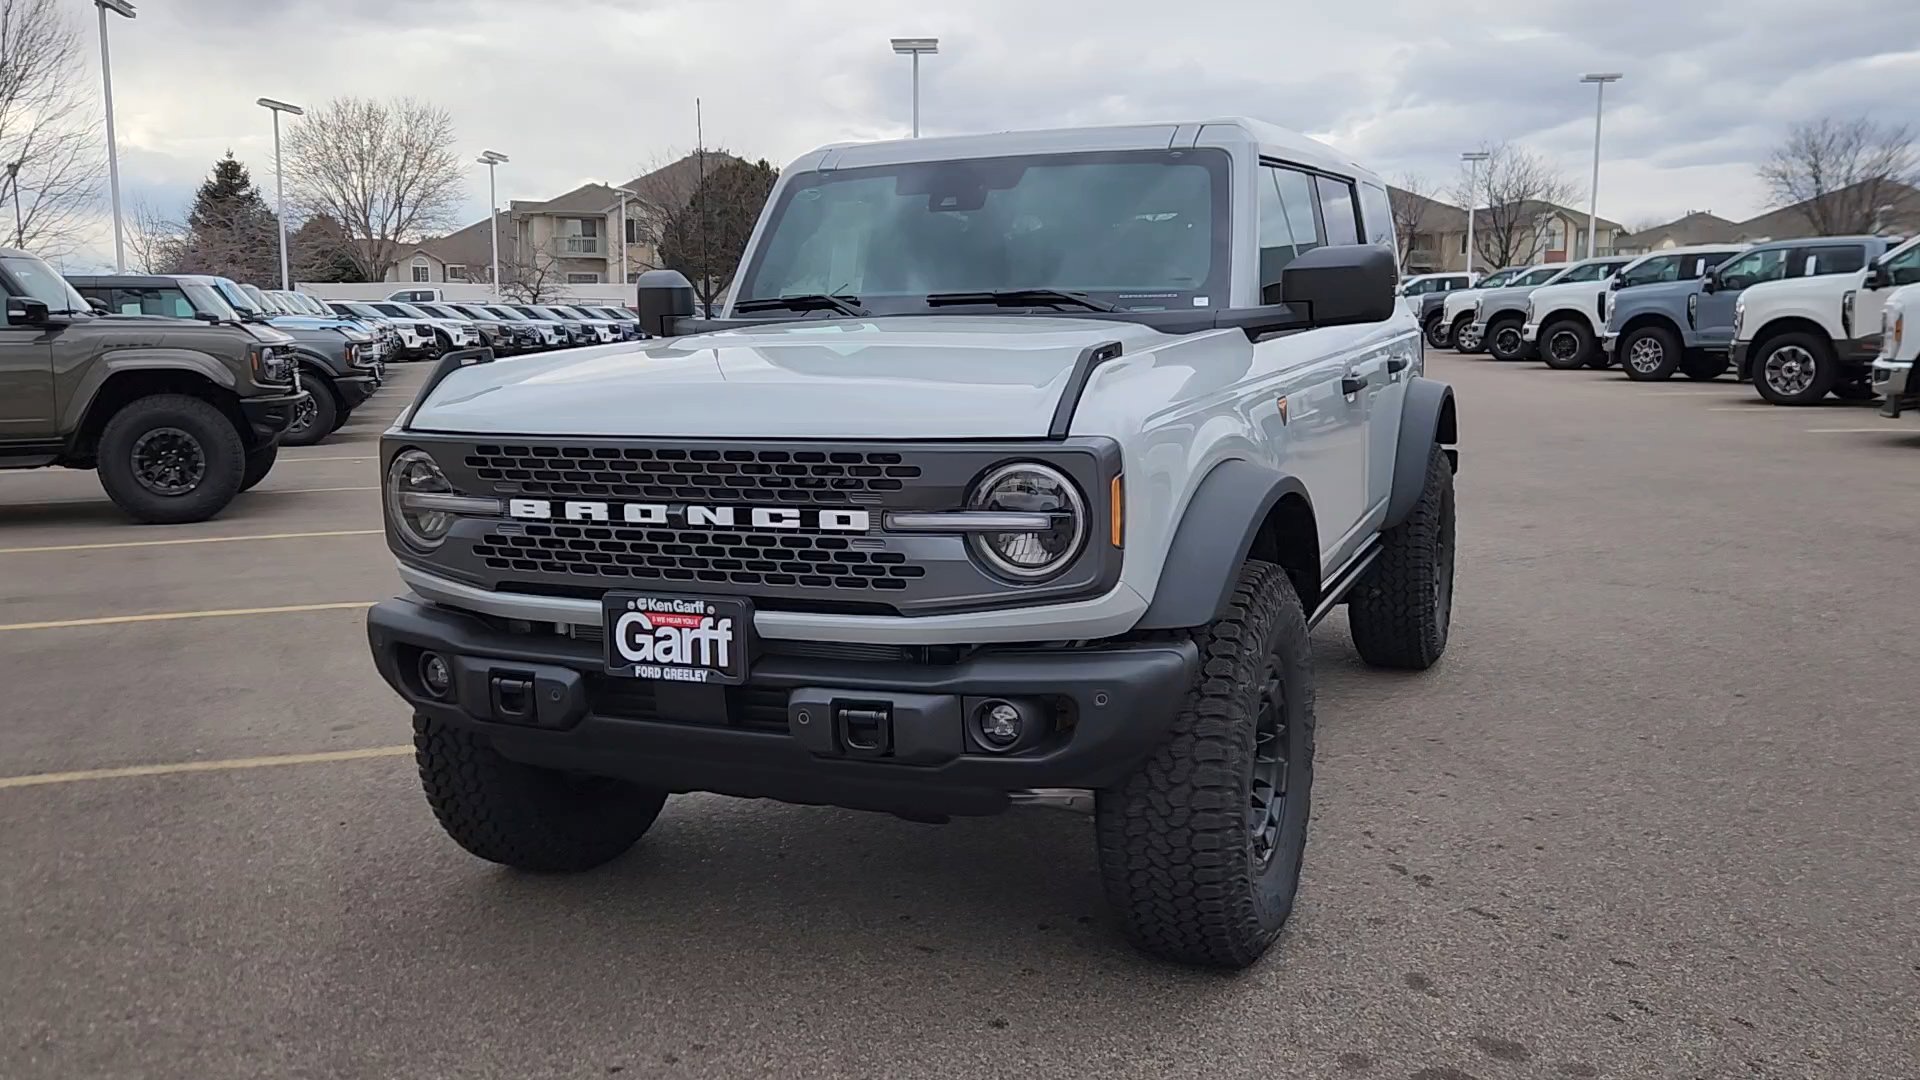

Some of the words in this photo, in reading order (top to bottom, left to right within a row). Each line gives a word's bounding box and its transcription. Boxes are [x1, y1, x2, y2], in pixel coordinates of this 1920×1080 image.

[509, 499, 870, 531] BRONCO
[648, 598, 673, 612] Ken
[673, 600, 704, 614] Garff
[615, 611, 733, 667] Garff
[635, 666, 661, 679] FORD
[663, 668, 708, 682] GREELEY
